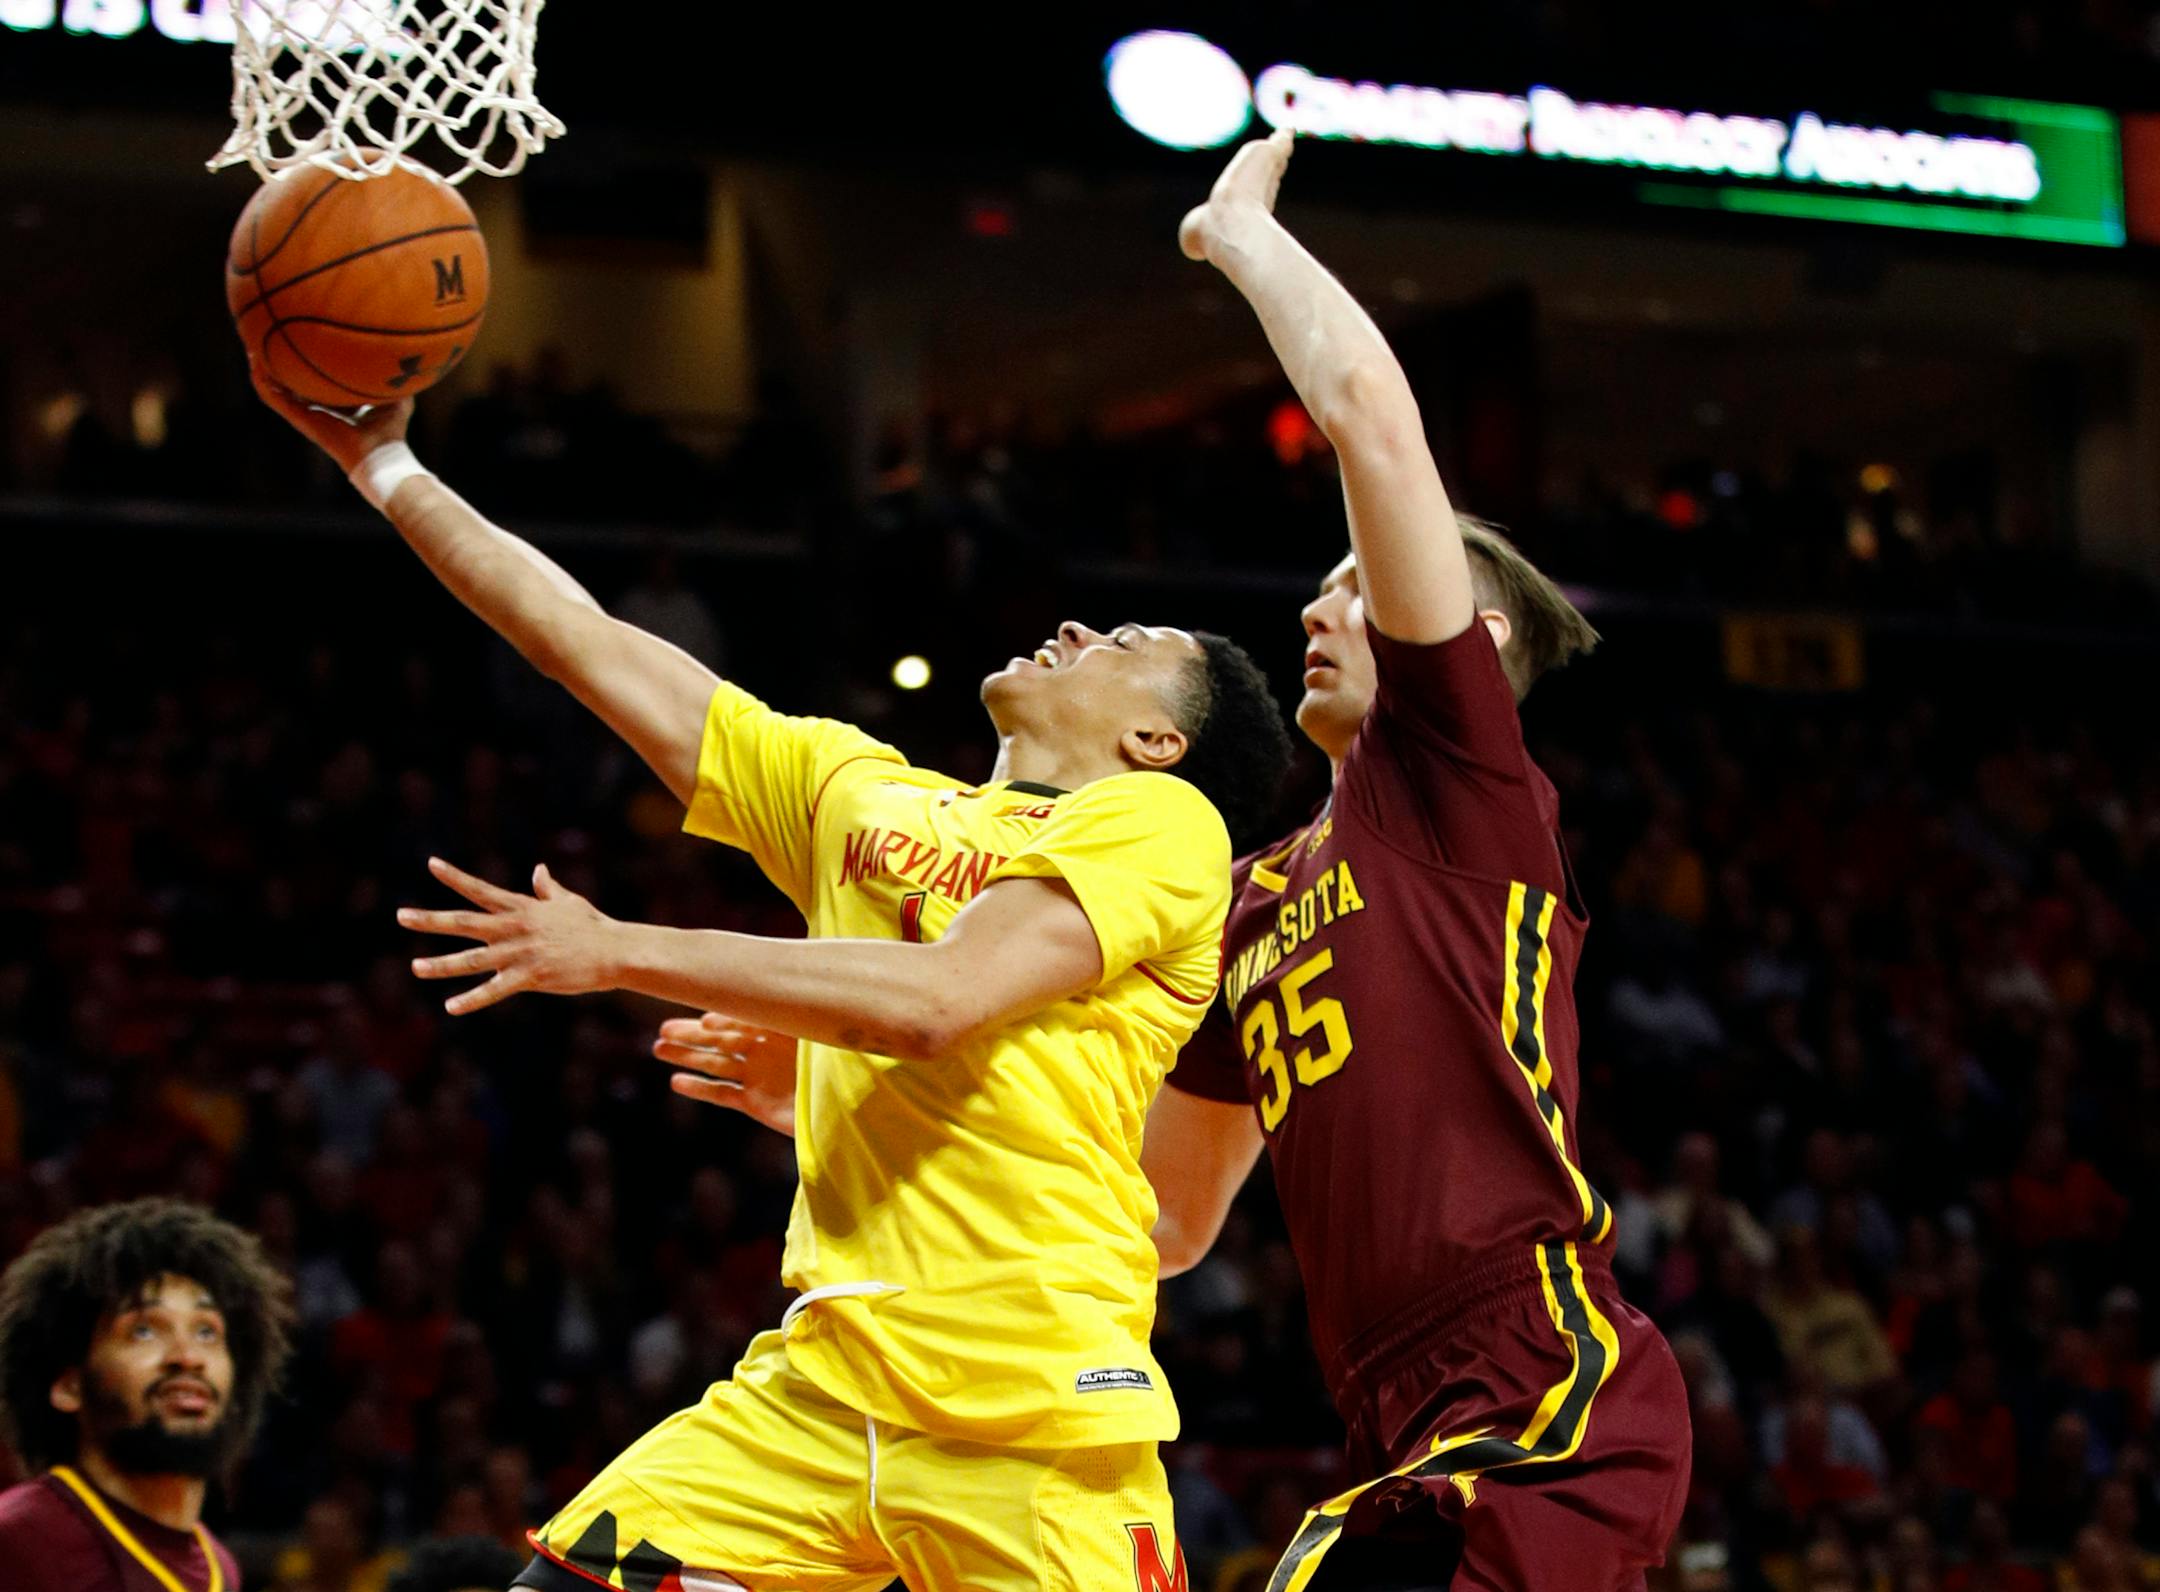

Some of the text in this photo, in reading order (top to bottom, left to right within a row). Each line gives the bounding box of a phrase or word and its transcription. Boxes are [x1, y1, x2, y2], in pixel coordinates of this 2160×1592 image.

[432, 254, 465, 301] M
[838, 827, 1010, 901] MARYLAN
[1225, 859, 1365, 1013] INNESOTA
[1242, 948, 1353, 1133] 35
[1079, 1371, 1138, 1384] AUTHENTC
[1124, 1522, 1190, 1592] M
